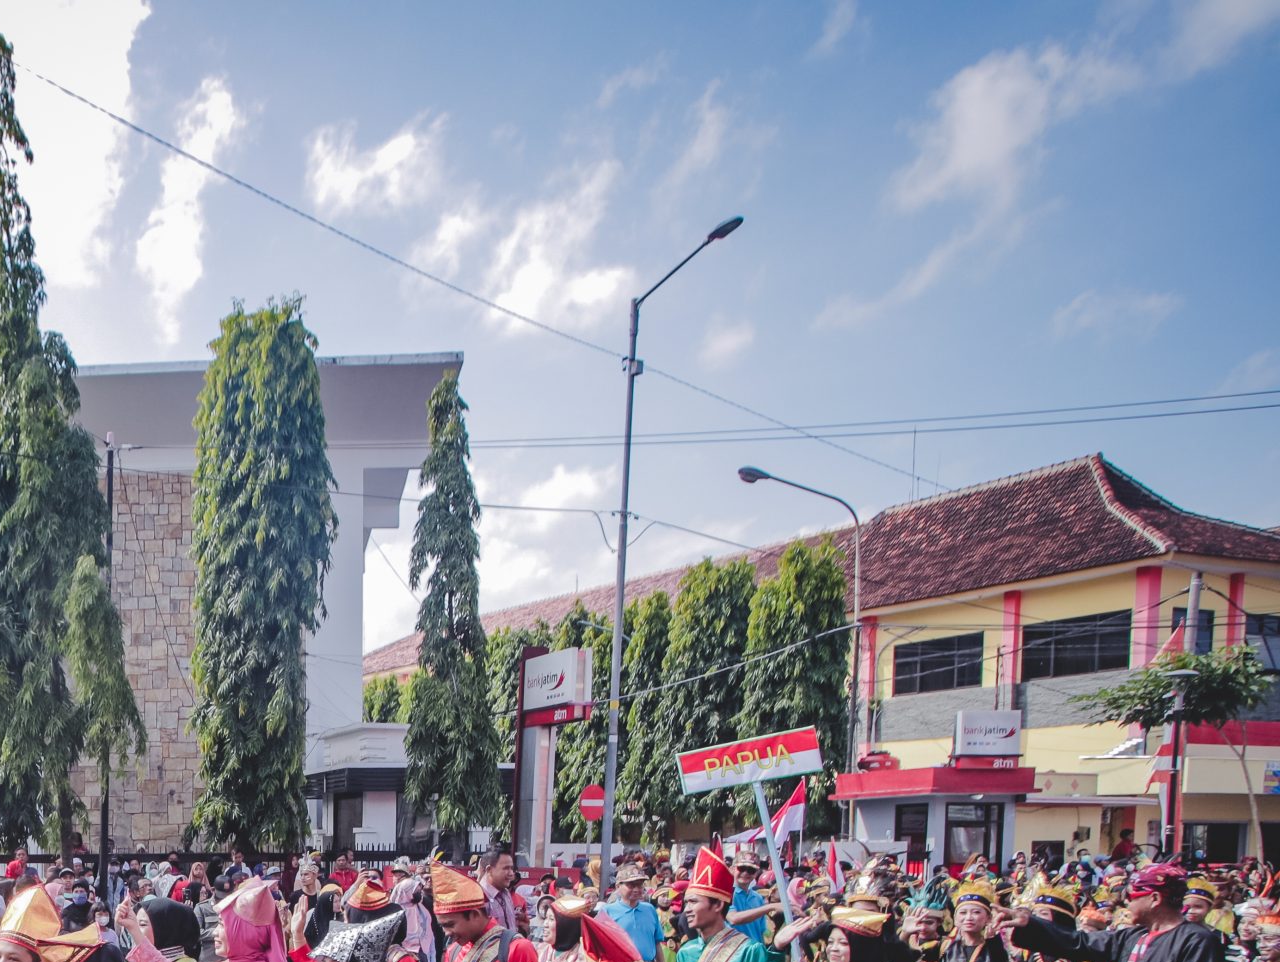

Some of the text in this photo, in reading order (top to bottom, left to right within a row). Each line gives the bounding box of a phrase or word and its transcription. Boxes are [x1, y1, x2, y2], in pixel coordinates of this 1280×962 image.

[554, 709, 567, 720] atm
[963, 725, 1008, 737] bankjatim
[704, 744, 795, 780] PAPUA
[993, 758, 1014, 768] atm
